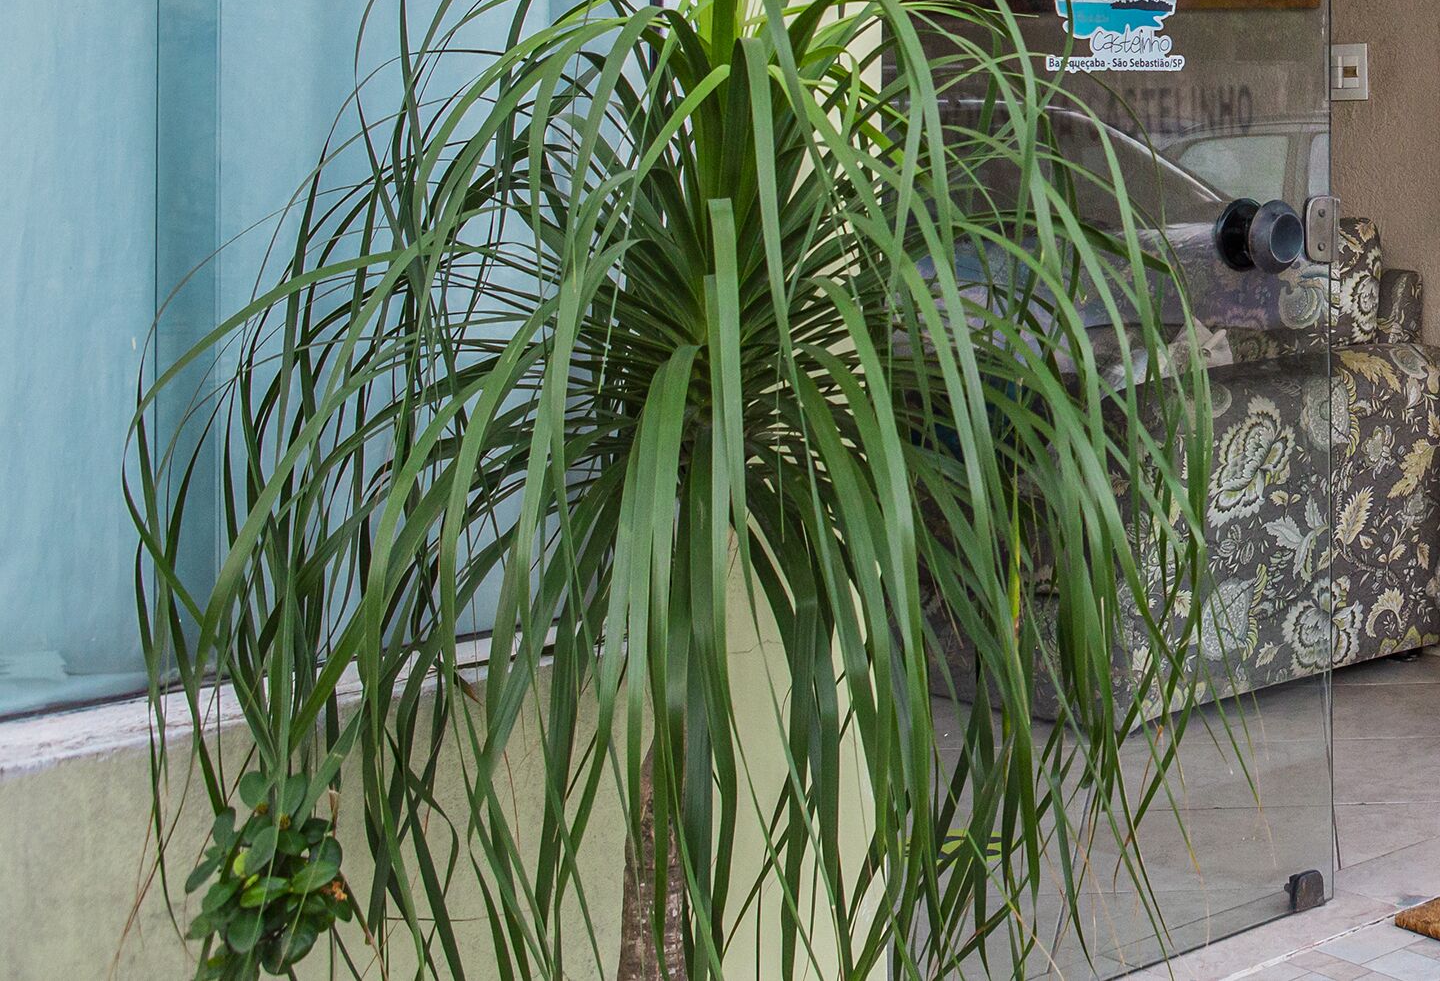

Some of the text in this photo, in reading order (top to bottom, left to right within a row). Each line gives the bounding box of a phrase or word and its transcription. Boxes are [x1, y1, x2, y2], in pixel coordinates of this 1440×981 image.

[1092, 28, 1170, 53] Castelinho
[1049, 58, 1105, 70] Baqueçaba
[1112, 58, 1128, 67] São
[1129, 58, 1183, 68] Sebastião/SP
